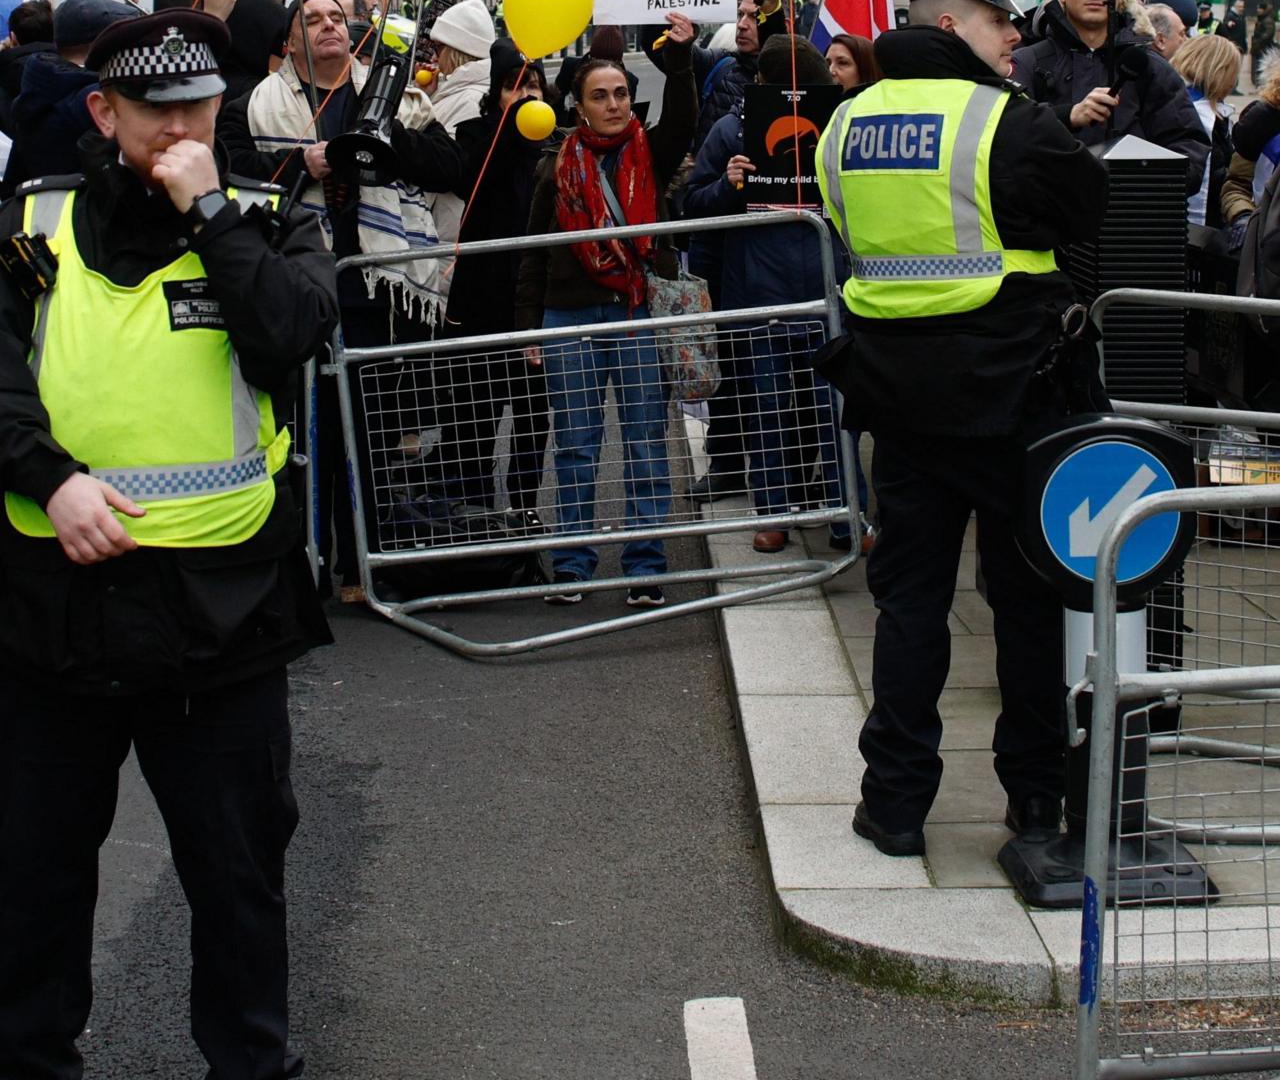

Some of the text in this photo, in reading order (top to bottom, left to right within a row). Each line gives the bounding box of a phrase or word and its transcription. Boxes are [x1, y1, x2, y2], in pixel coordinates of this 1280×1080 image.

[846, 123, 936, 160] POLICE
[748, 176, 772, 185] Bring
[774, 177, 788, 185] my
